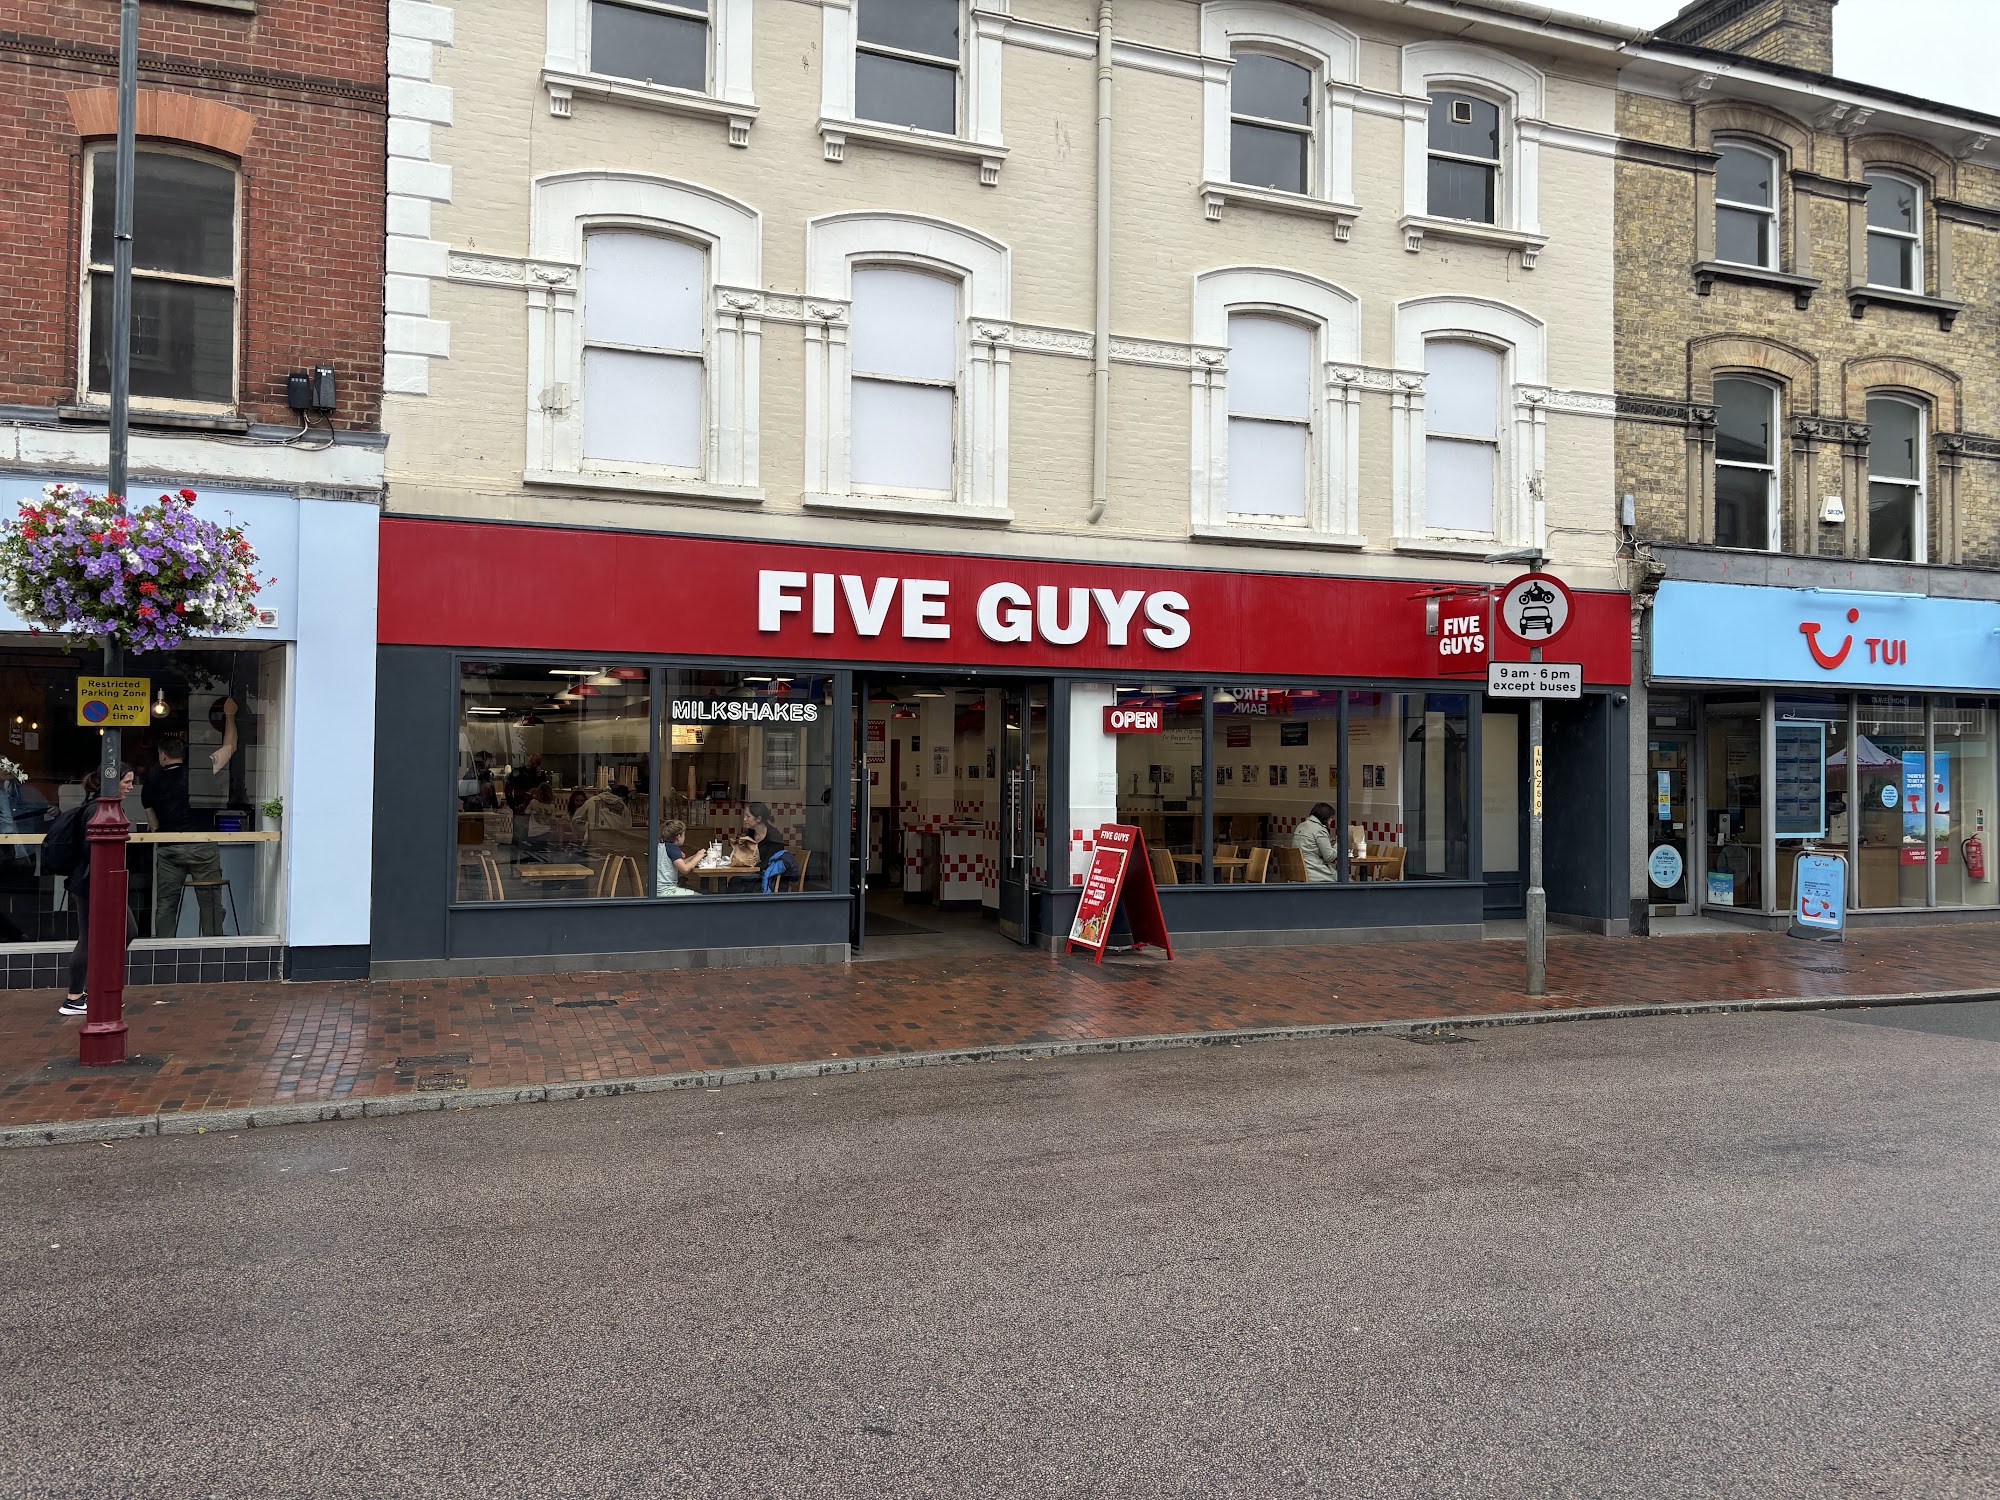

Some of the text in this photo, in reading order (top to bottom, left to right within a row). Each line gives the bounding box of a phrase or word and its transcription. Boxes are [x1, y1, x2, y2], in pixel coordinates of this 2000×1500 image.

[758, 569, 1191, 649] FIVE GUYS
[1443, 615, 1480, 636] FIVE
[1439, 635, 1485, 655] GUYS
[1865, 638, 1906, 665] TUI
[1500, 668, 1508, 678] 9
[1511, 670, 1529, 678] am
[1540, 668, 1548, 679] 6
[1551, 671, 1570, 681] pm
[81, 689, 147, 697] Parking Zone
[88, 680, 140, 688] Restricted
[1493, 681, 1576, 692] except buses
[672, 700, 818, 722] MILKSHAKES
[1110, 711, 1158, 729] OPEN
[1100, 830, 1130, 842] FIVE GUYS
